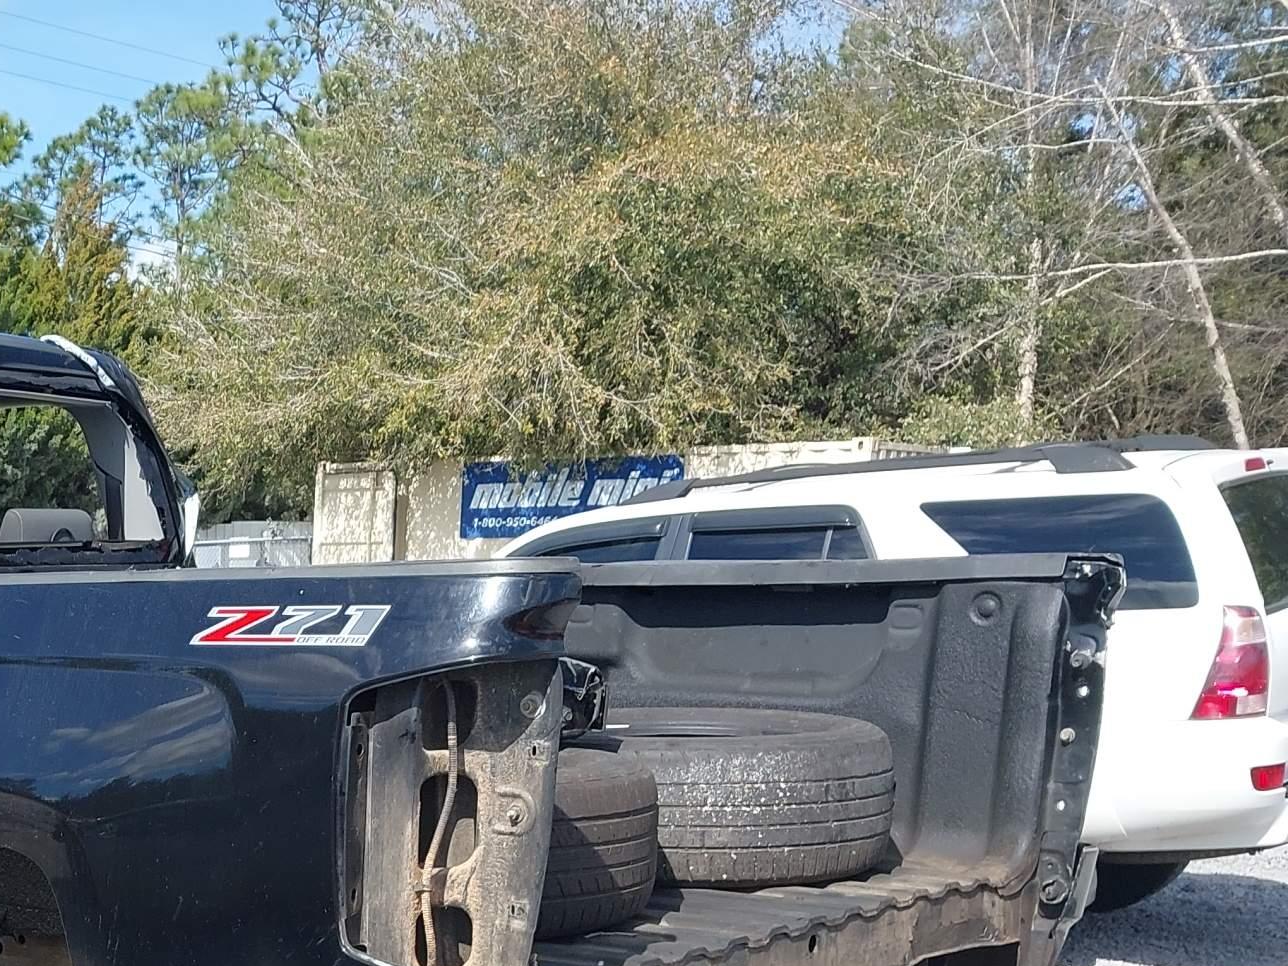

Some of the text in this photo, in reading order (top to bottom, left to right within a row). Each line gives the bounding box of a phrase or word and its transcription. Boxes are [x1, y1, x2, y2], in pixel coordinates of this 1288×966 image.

[469, 468, 585, 509] mobile
[189, 604, 392, 646] Z71
[296, 635, 367, 645] OFF ROAD
